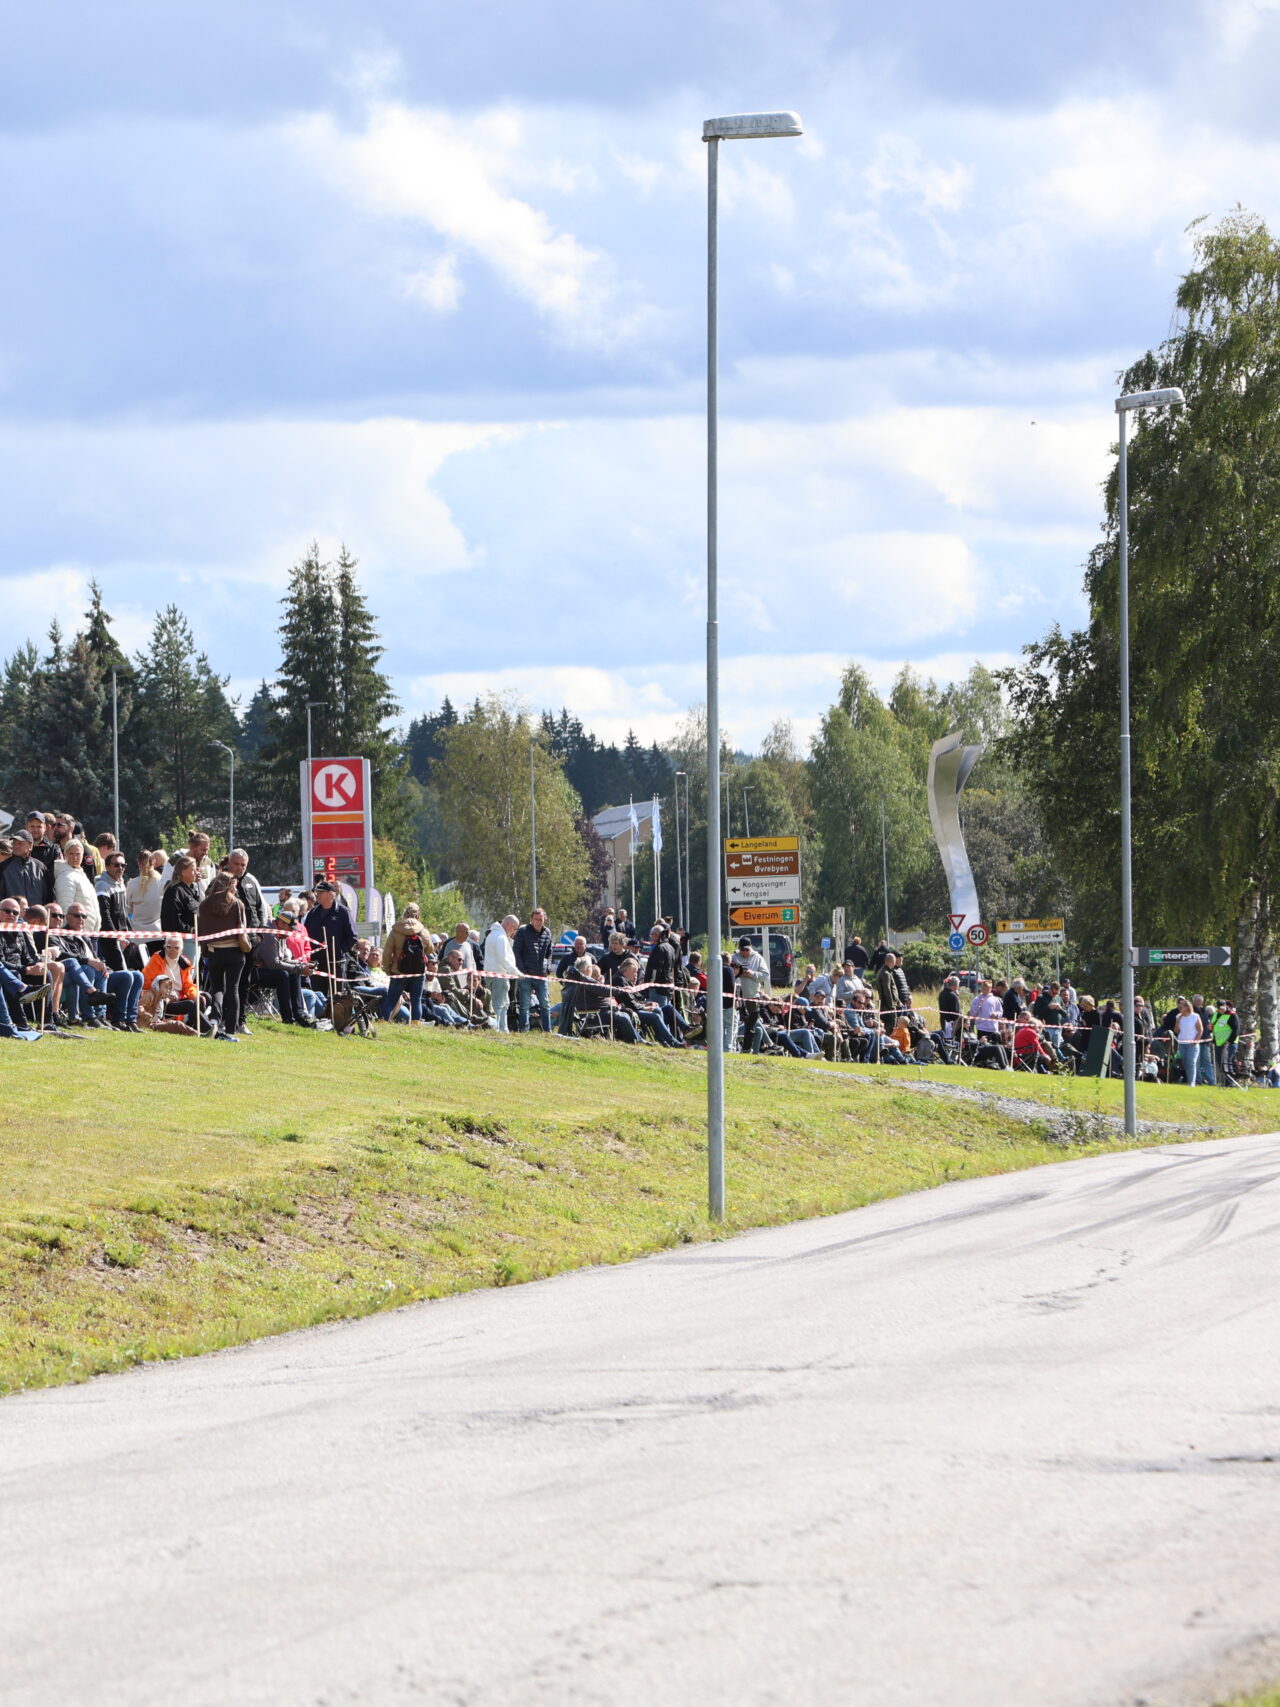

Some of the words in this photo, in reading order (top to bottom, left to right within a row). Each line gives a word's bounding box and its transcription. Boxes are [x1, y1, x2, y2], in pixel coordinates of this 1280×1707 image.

[325, 773, 354, 805] K
[741, 841, 777, 849] Langeland
[314, 859, 324, 867] 95
[743, 890, 769, 898] fengsel
[743, 911, 779, 920] Elverum
[785, 911, 791, 919] 2
[971, 930, 985, 941] 50
[1153, 952, 1209, 961] enterprise
